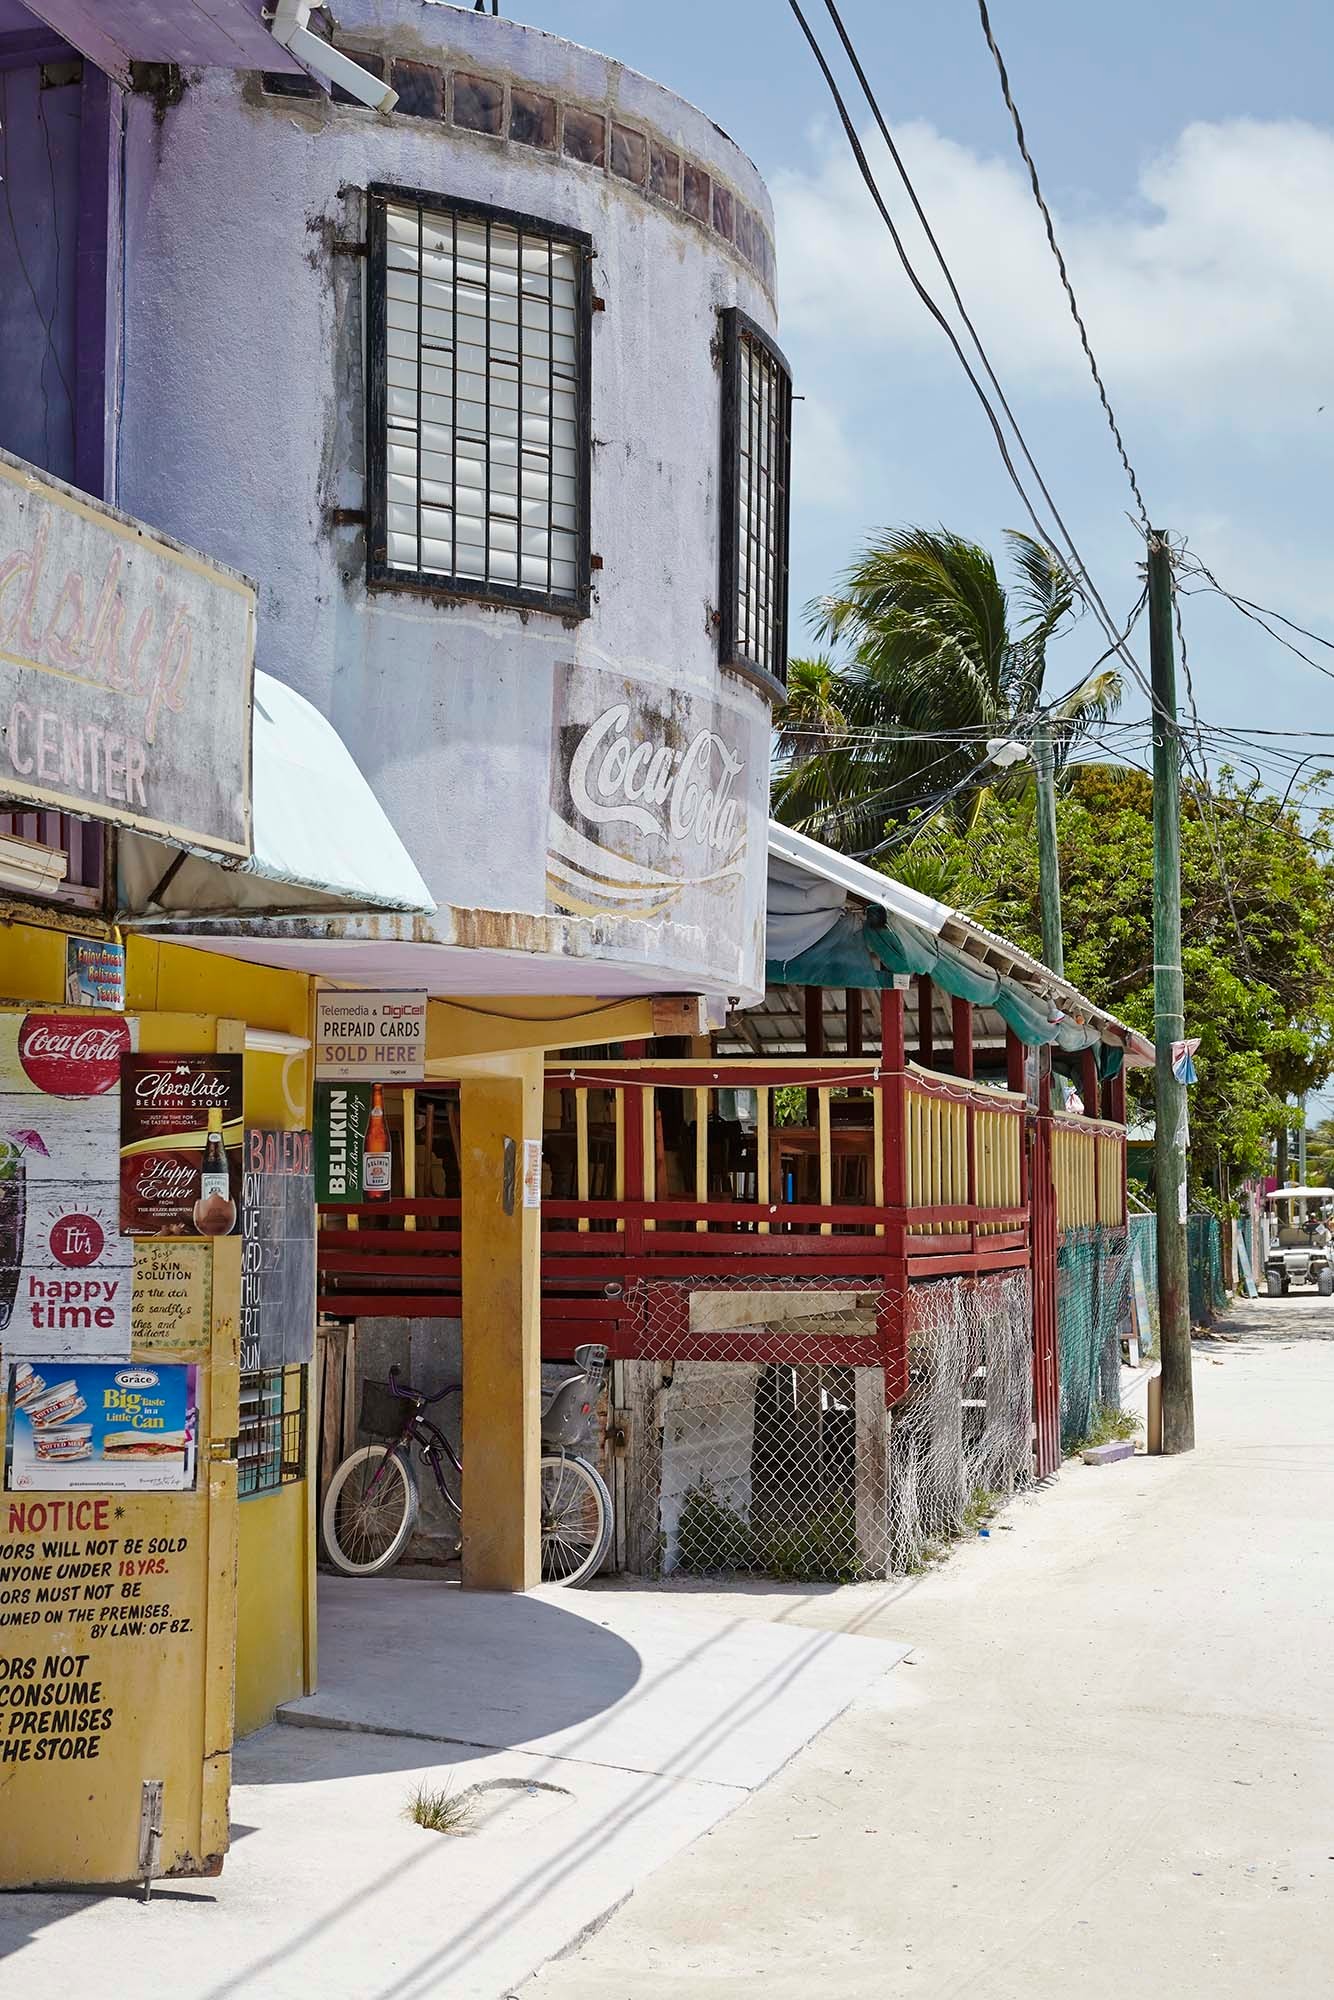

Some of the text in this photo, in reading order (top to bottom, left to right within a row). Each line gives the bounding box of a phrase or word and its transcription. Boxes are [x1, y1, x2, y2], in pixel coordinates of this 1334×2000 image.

[8, 701, 148, 808] CENTER
[568, 703, 746, 852] Coca-Cola
[78, 946, 123, 968] Enjoy Great
[88, 965, 122, 985] Belizean
[319, 1004, 369, 1016] Telemedia
[382, 1004, 425, 1019] DigiCell
[323, 1022, 420, 1037] PREPAID CARDS
[24, 1026, 126, 1061] Coca-Cola
[325, 1046, 417, 1062] SOLD HERE
[135, 1072, 230, 1100] Chocolate
[347, 1122, 365, 1139] of
[329, 1090, 347, 1194] BELIKIN
[350, 1141, 359, 1166] Beer
[140, 1157, 198, 1186] Happy
[347, 1168, 358, 1190] The
[136, 1179, 193, 1200] Easter
[62, 1225, 92, 1255] It's
[151, 1262, 180, 1271] SKIN
[264, 1246, 280, 1272] 29
[136, 1270, 192, 1280] SOLUTION
[29, 1275, 120, 1303] happy
[147, 1288, 165, 1297] the
[167, 1288, 188, 1298] itch
[31, 1301, 116, 1329] time
[157, 1319, 177, 1329] and
[240, 1339, 260, 1371] SUN
[120, 1375, 152, 1384] Grace
[35, 1404, 59, 1419] POTTED
[103, 1388, 166, 1415] Big Taste
[144, 1407, 152, 1415] in
[106, 1413, 165, 1429] Little Can
[8, 1500, 110, 1534] NOTICE
[42, 1541, 81, 1558] WILL
[85, 1539, 119, 1556] NOT
[124, 1538, 144, 1554] BE
[147, 1537, 188, 1554] SOLD
[56, 1562, 112, 1579] UNDER
[118, 1560, 135, 1577] 18
[138, 1558, 169, 1575] YRS.
[0, 1582, 142, 1605] ORS MUST NOT BE
[44, 1610, 63, 1623] ON
[68, 1608, 96, 1622] THE
[100, 1604, 173, 1622] PREMISES.
[91, 1624, 108, 1639] BY
[111, 1622, 146, 1637] LAW:
[149, 1622, 169, 1635] OF
[42, 1655, 90, 1679] NOT
[0, 1681, 102, 1708] CONSUME
[8, 1707, 114, 1735] PREMISES
[33, 1735, 101, 1760] STORE
